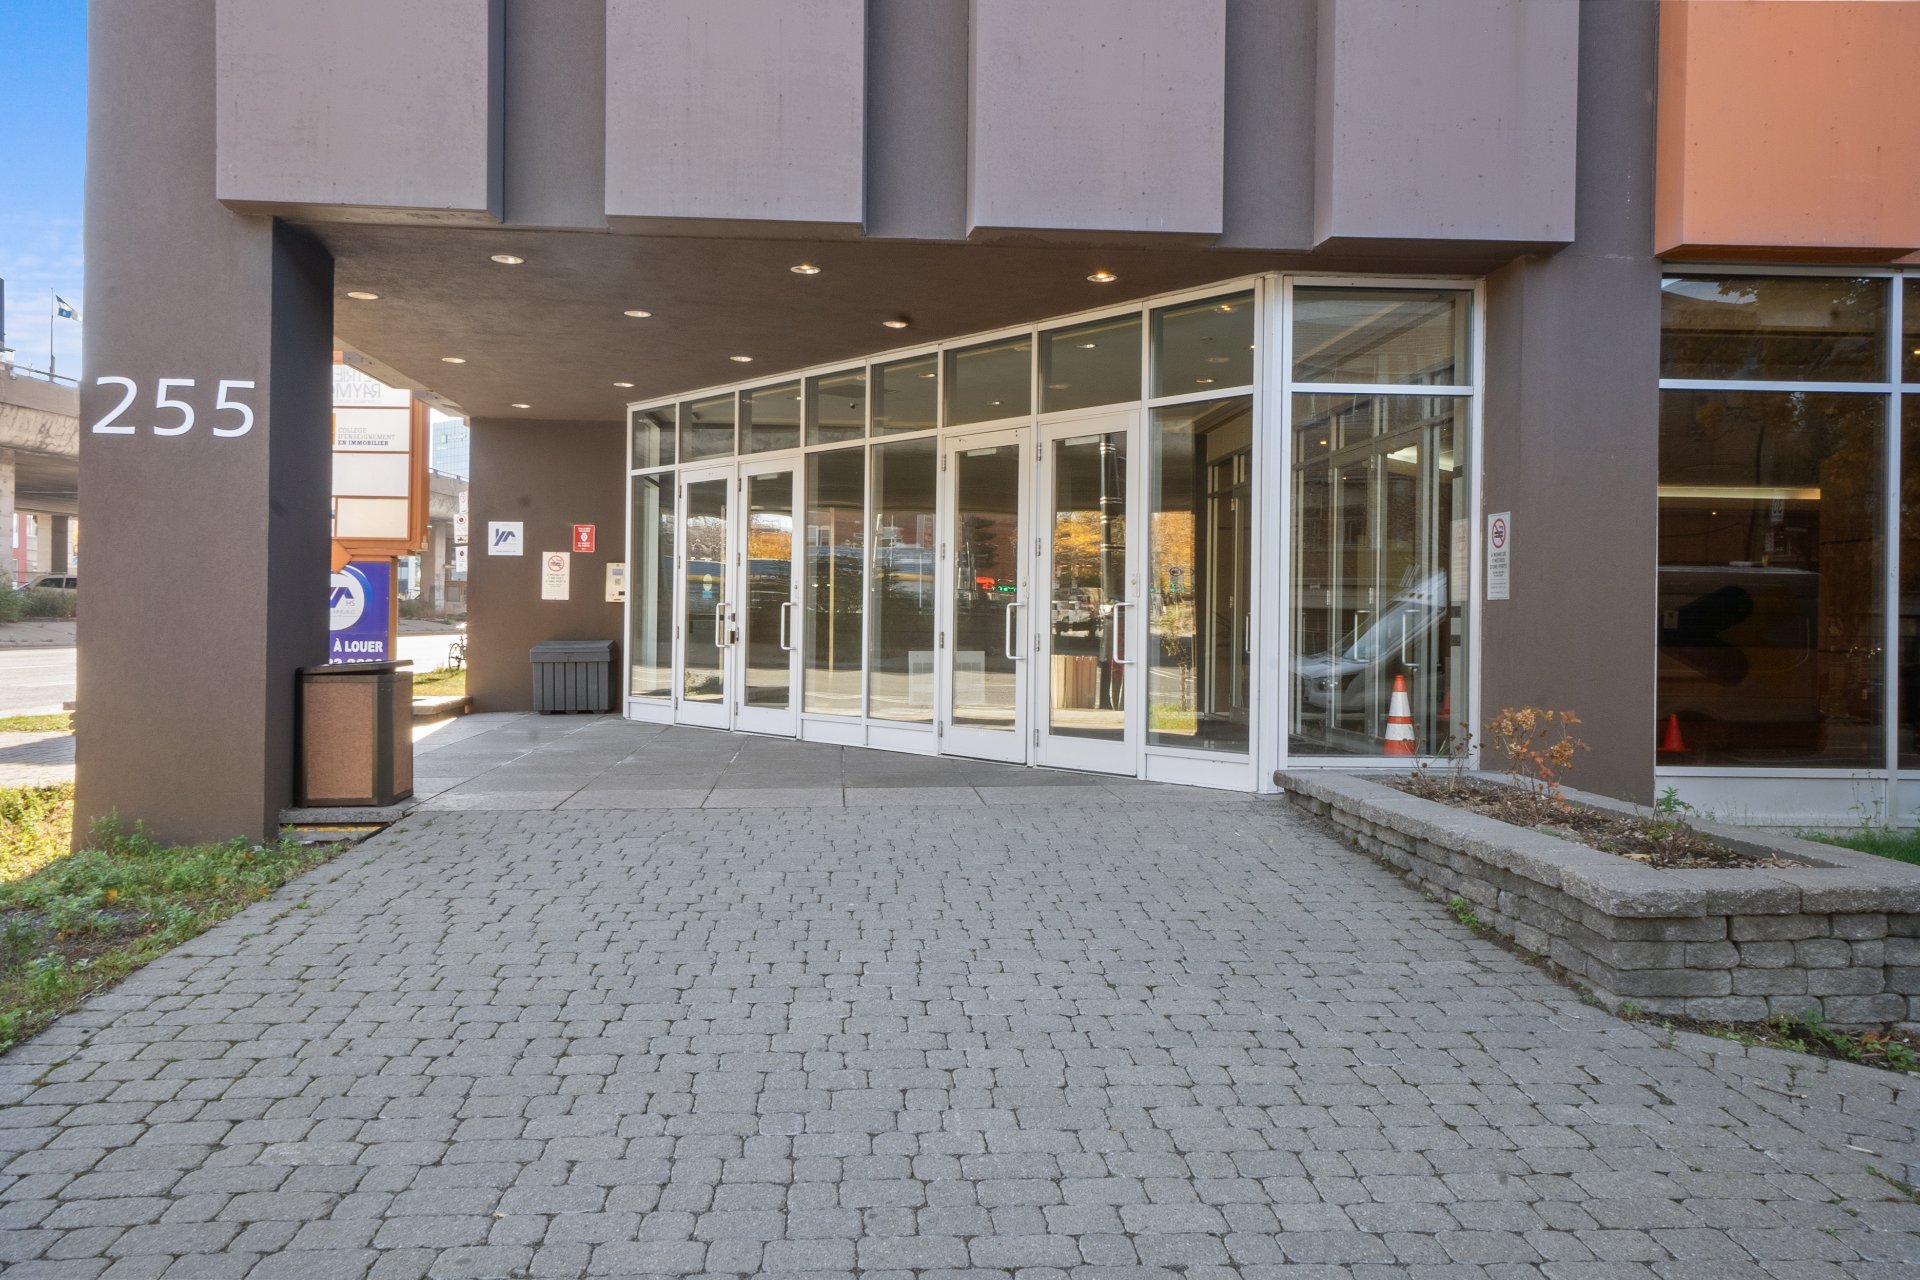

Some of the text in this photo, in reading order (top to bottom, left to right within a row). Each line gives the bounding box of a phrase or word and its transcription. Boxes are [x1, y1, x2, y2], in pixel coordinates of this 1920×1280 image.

[91, 375, 257, 438] 255
[334, 638, 384, 652] À LOUER
